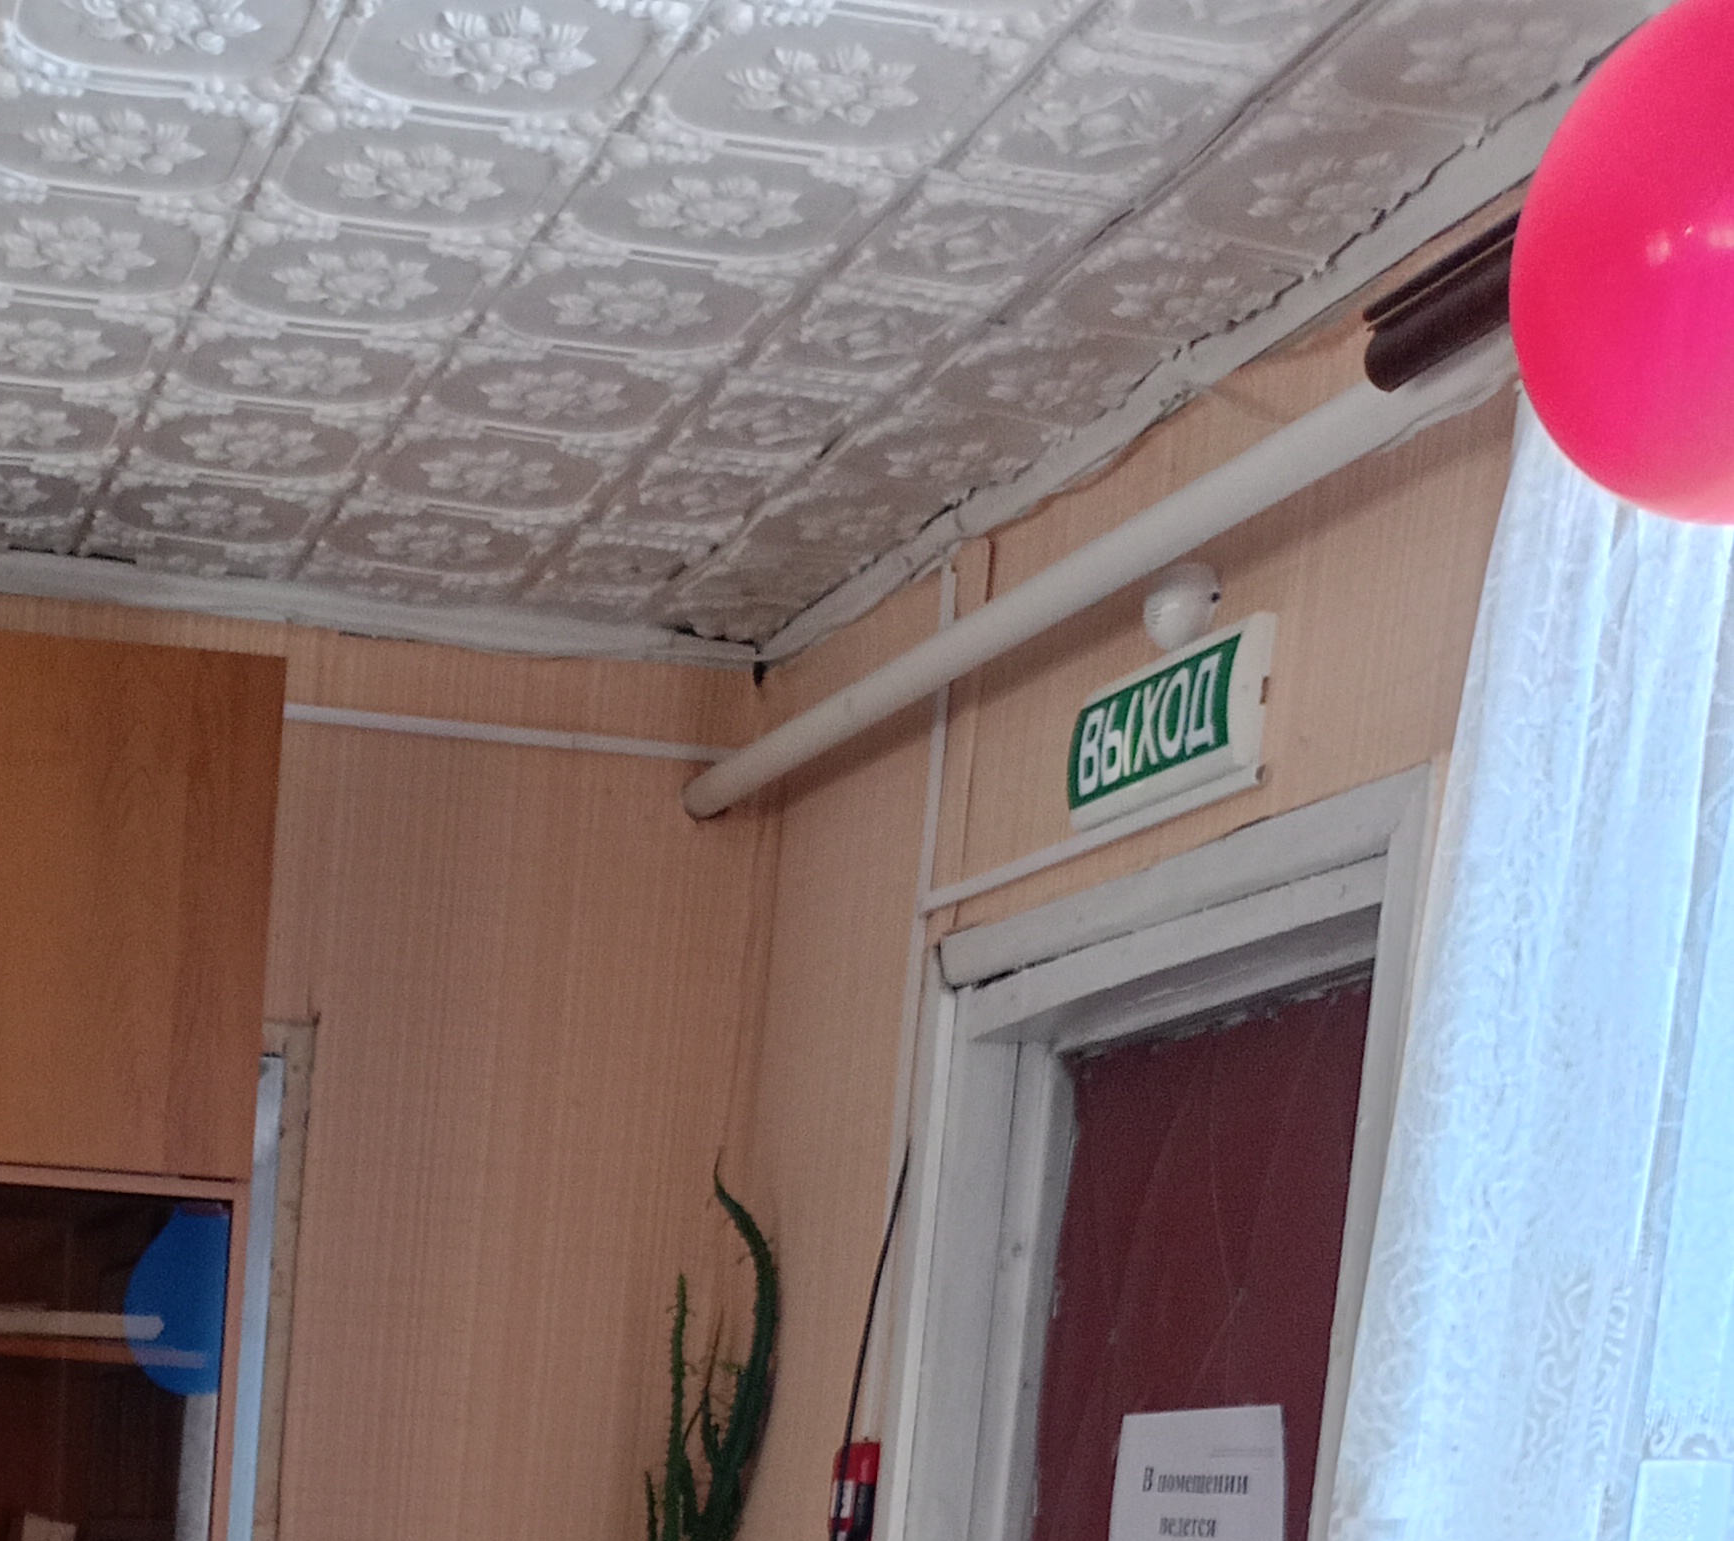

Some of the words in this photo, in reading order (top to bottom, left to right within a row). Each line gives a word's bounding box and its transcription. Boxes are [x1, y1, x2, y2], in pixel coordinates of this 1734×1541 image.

[1078, 652, 1222, 796] ВЫХОД
[1142, 1465, 1154, 1493] В
[1157, 1470, 1249, 1496] помещении
[1159, 1514, 1217, 1539] ведется
